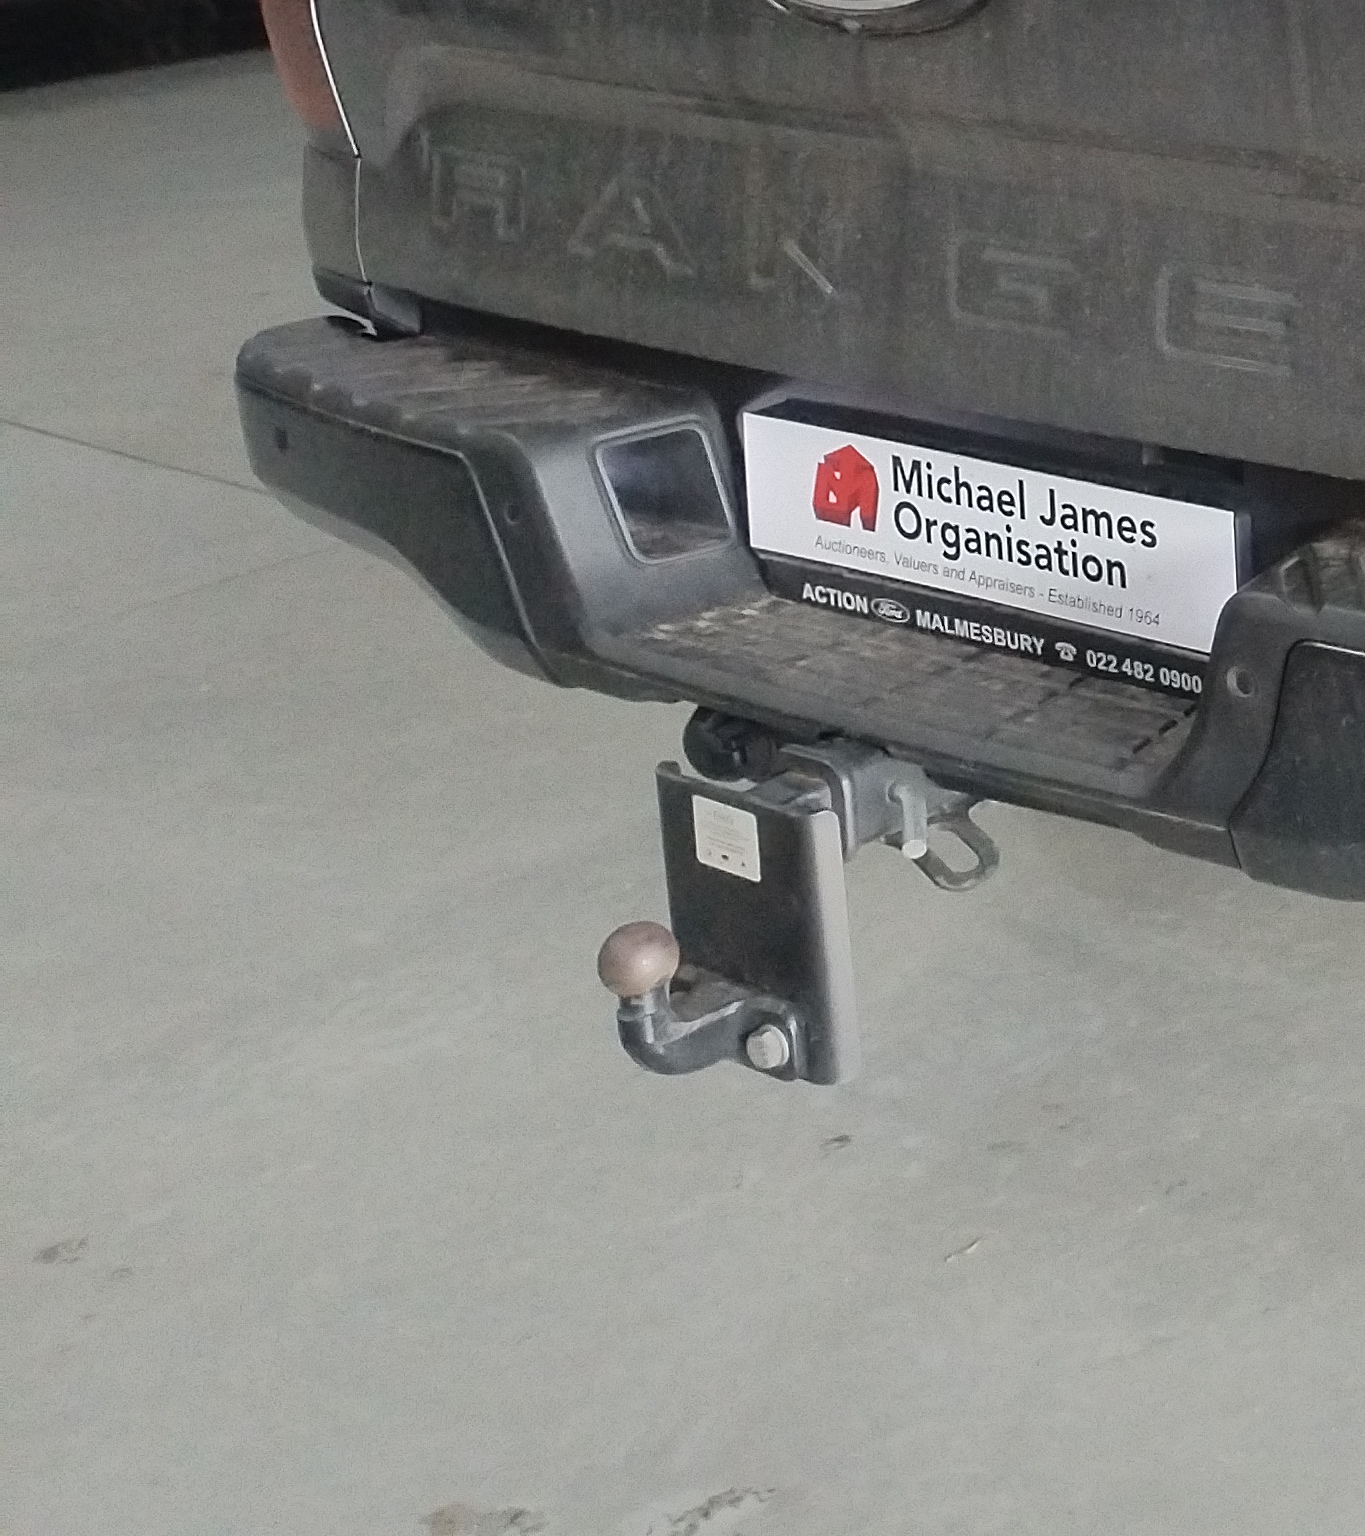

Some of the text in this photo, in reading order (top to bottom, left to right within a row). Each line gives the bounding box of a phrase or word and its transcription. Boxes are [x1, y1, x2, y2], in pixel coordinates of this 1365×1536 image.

[891, 454, 1159, 549] Michael James
[893, 500, 1128, 590] Organisation
[894, 551, 939, 576] Valuers
[942, 565, 966, 581] and
[968, 570, 1036, 600] Appraisers
[1047, 588, 1123, 619] Established
[1128, 607, 1161, 627] 1964
[802, 582, 870, 615] ACTION
[915, 608, 1045, 656] MALMESBURY
[1085, 649, 1120, 674] 022
[1121, 657, 1156, 683] 482
[1159, 666, 1203, 694] 0900
